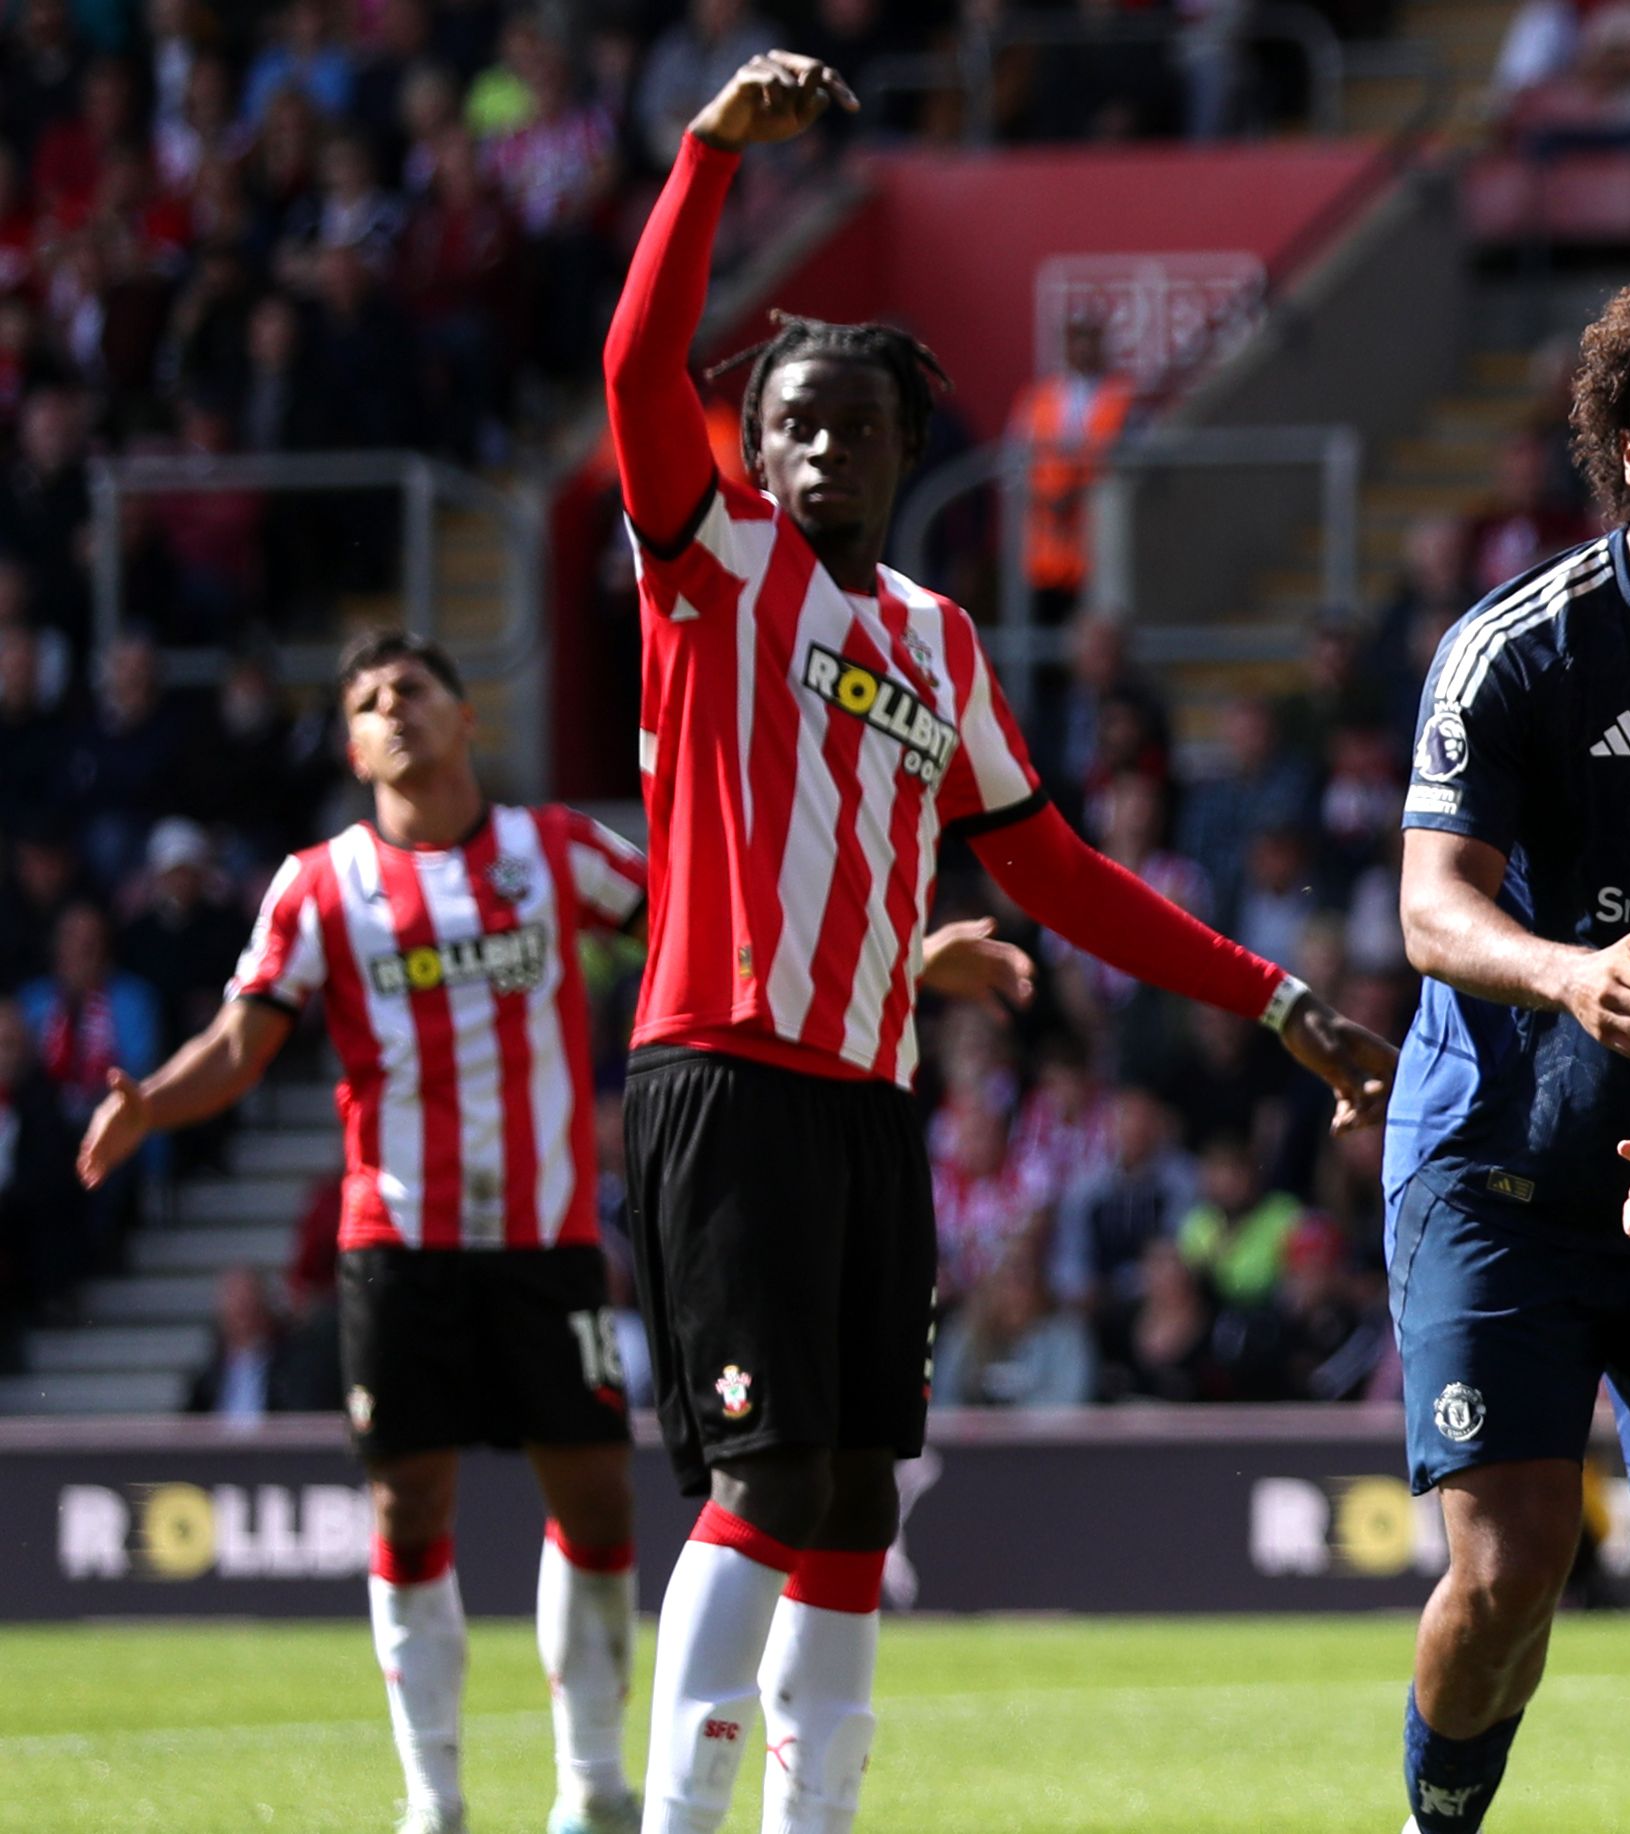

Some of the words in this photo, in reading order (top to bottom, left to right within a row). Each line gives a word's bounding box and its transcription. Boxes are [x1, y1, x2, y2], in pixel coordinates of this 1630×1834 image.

[806, 648, 959, 766] ROLLBIT
[60, 1482, 372, 1580] ROLLB
[704, 1718, 741, 1742] SFC
